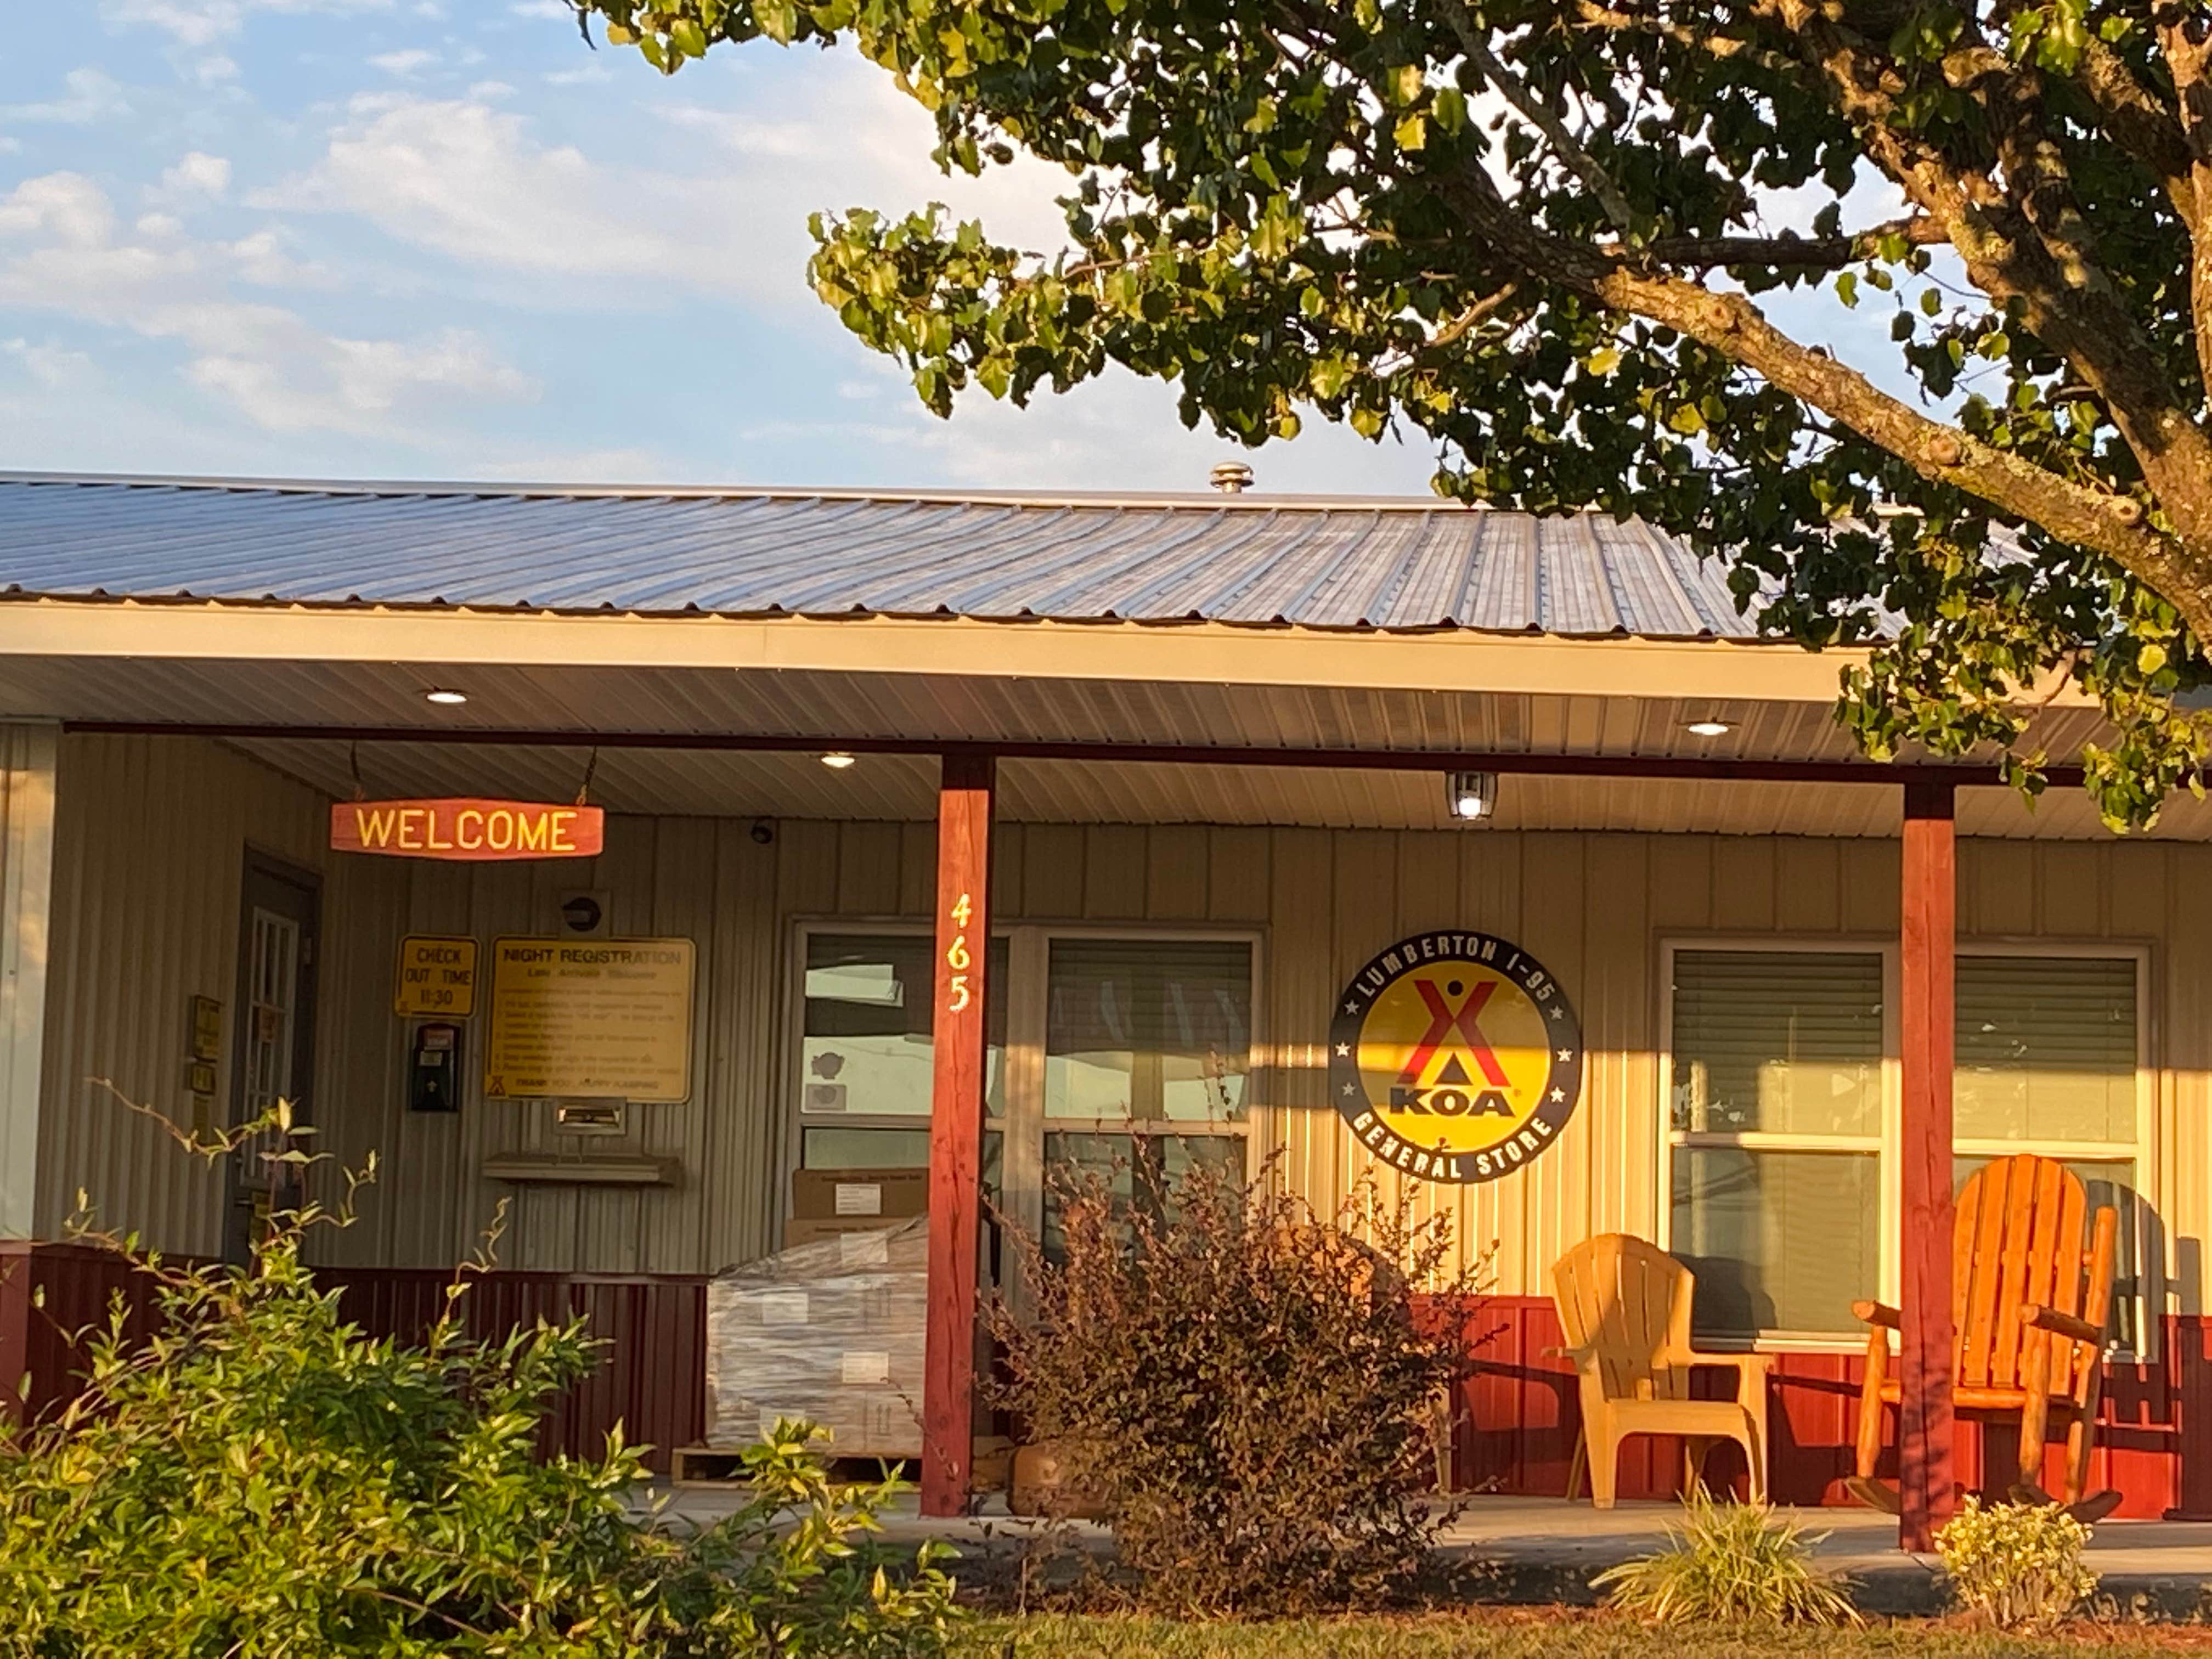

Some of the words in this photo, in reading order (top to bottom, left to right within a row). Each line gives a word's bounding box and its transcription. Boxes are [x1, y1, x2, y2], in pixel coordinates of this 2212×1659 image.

[356, 809, 577, 850] WELCOME
[417, 947, 461, 964] CHECK
[503, 949, 554, 963] NIGHT
[560, 949, 681, 964] REGISTRATION
[947, 893, 972, 1012] 465
[1356, 935, 1497, 998] LUMBERTON
[1505, 952, 1556, 1002] I-95
[405, 968, 430, 983] OUT
[442, 969, 472, 985] TIME
[1390, 1087, 1516, 1118] KOA
[1352, 1110, 1462, 1178] GENERAL
[1476, 1117, 1553, 1175] STORE
